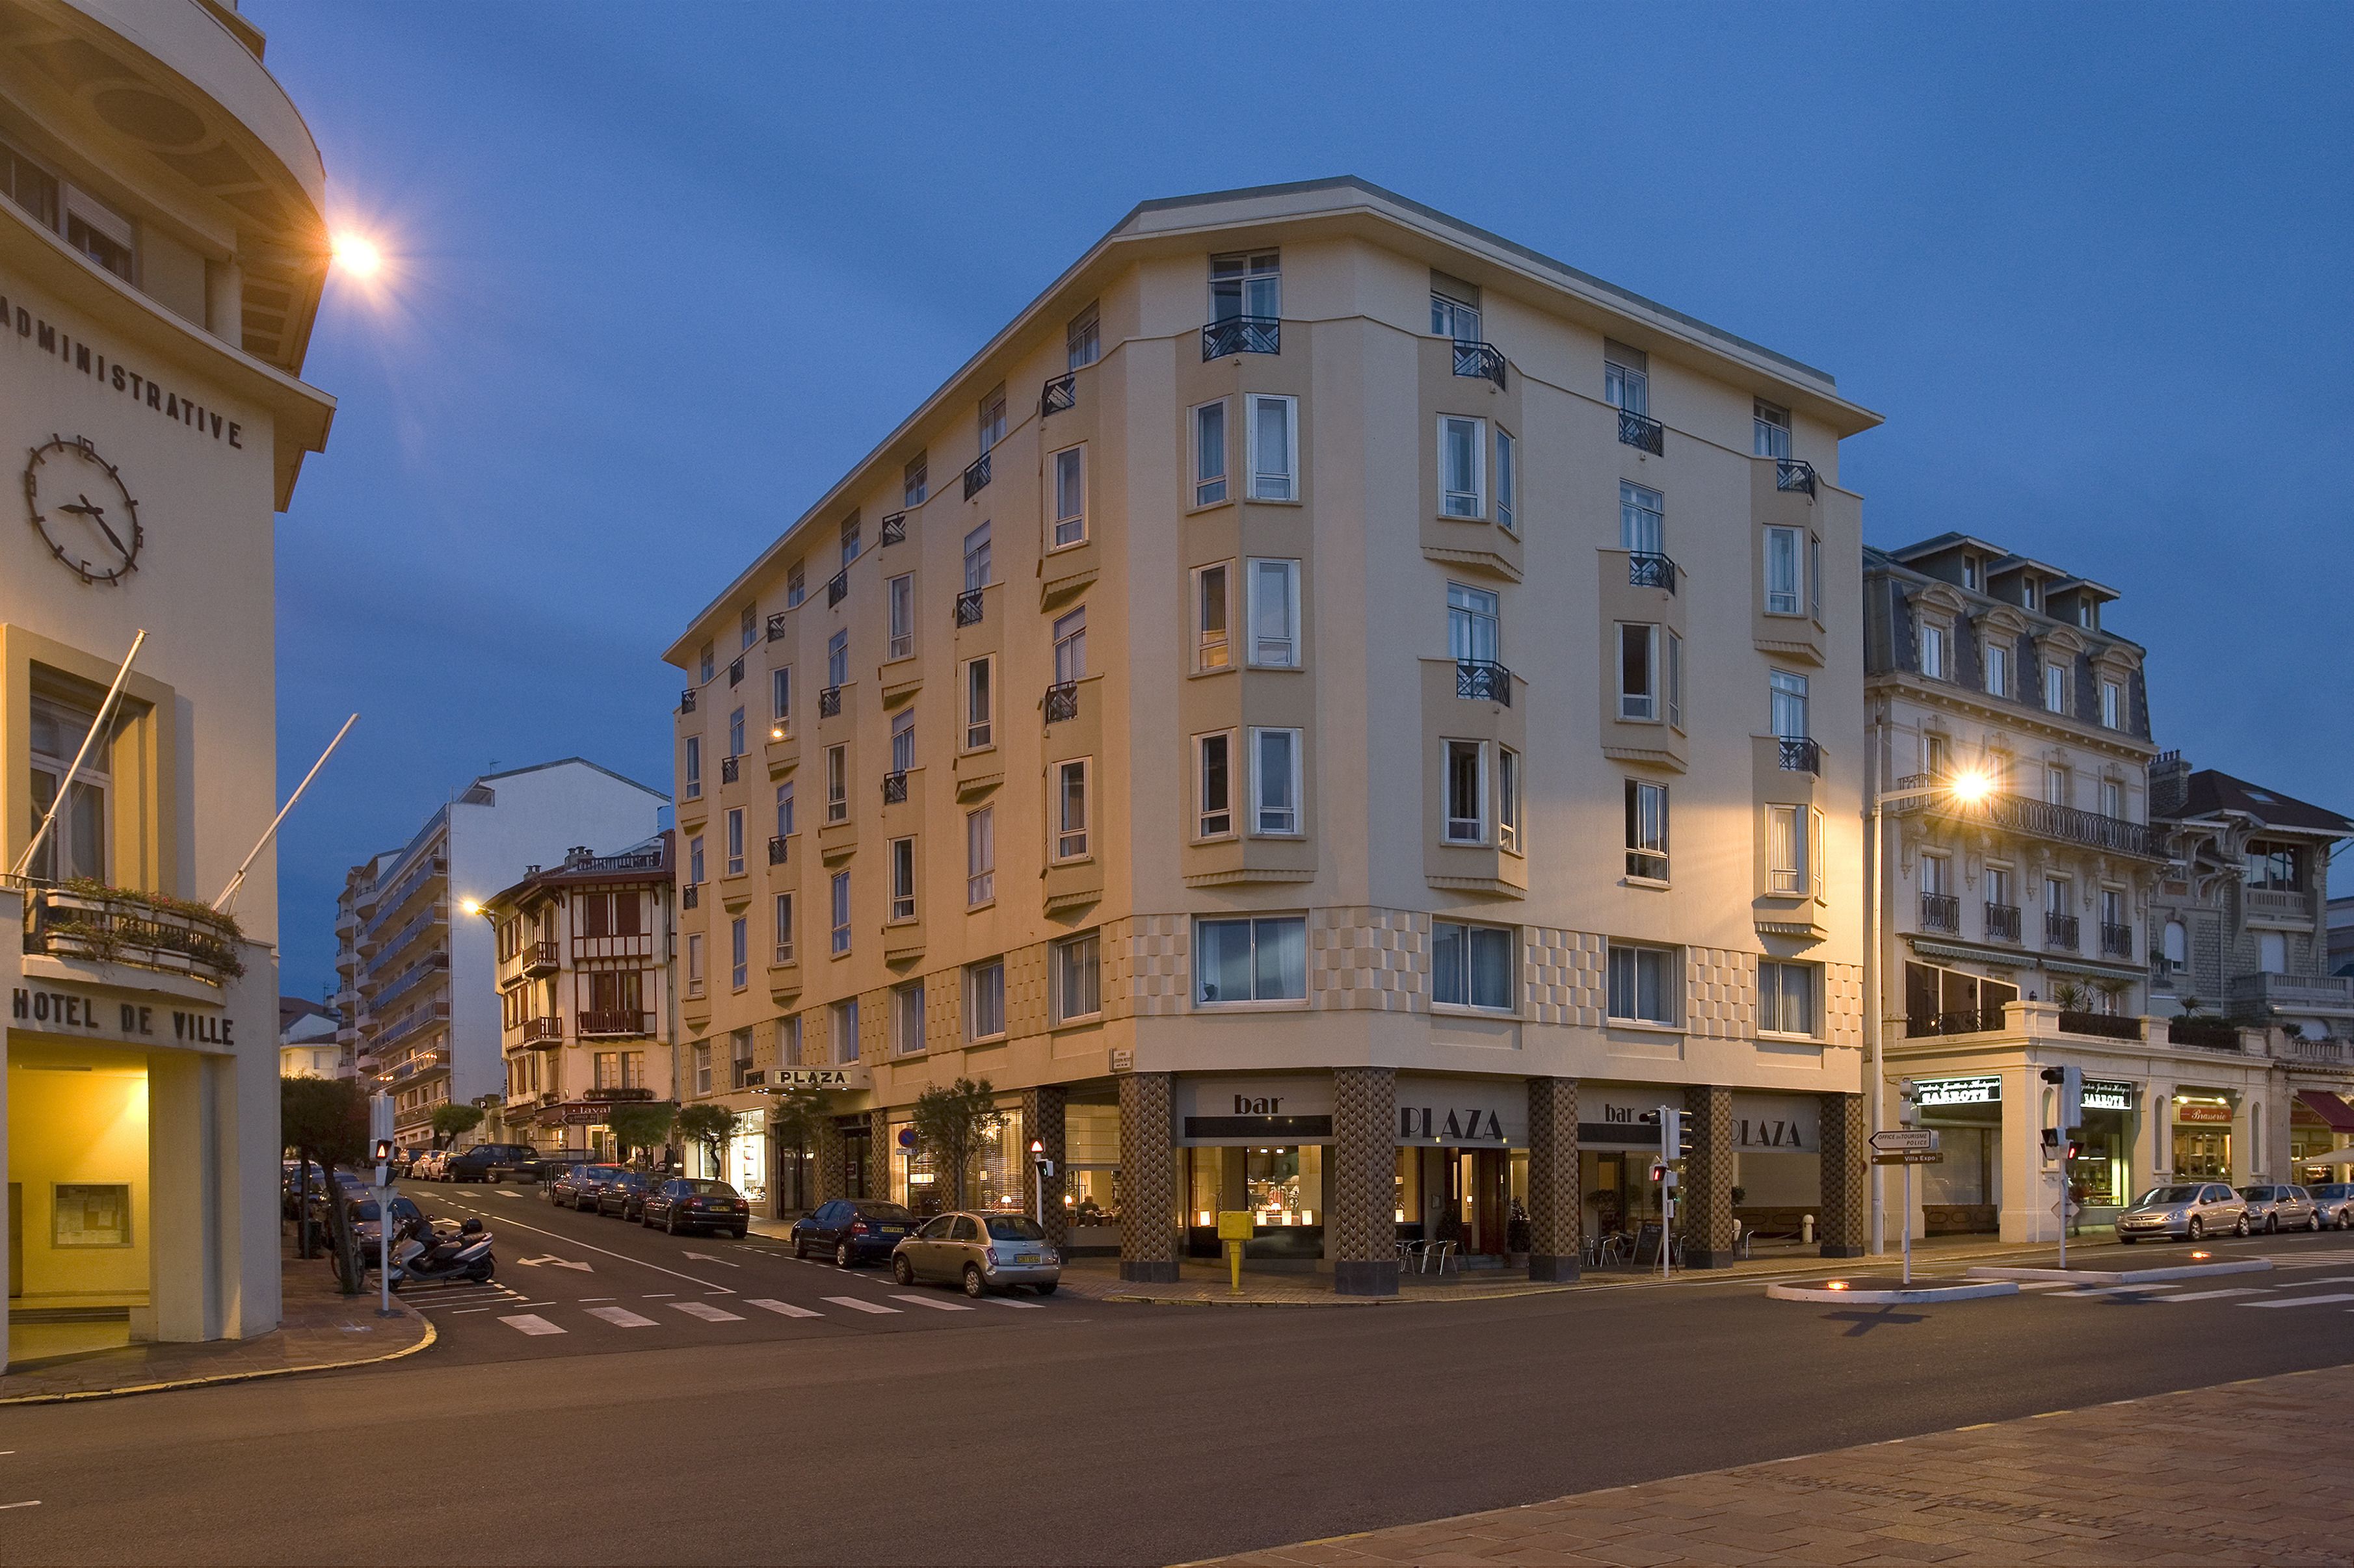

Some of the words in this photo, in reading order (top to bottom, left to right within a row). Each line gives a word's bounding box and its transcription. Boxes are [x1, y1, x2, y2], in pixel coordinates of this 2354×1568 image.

[0, 296, 243, 449] ADMINISTRATIVE
[77, 435, 96, 463] 12
[81, 560, 92, 585] 6
[13, 987, 98, 1028] HOTEL
[121, 1003, 153, 1035] DE
[173, 1011, 235, 1045] VILLE
[780, 1071, 845, 1083] PLAZA
[1234, 1094, 1284, 1115] bar
[1605, 1104, 1635, 1123] bar
[2191, 1108, 2227, 1121] Brasserie
[1401, 1107, 1504, 1140] PLAZA
